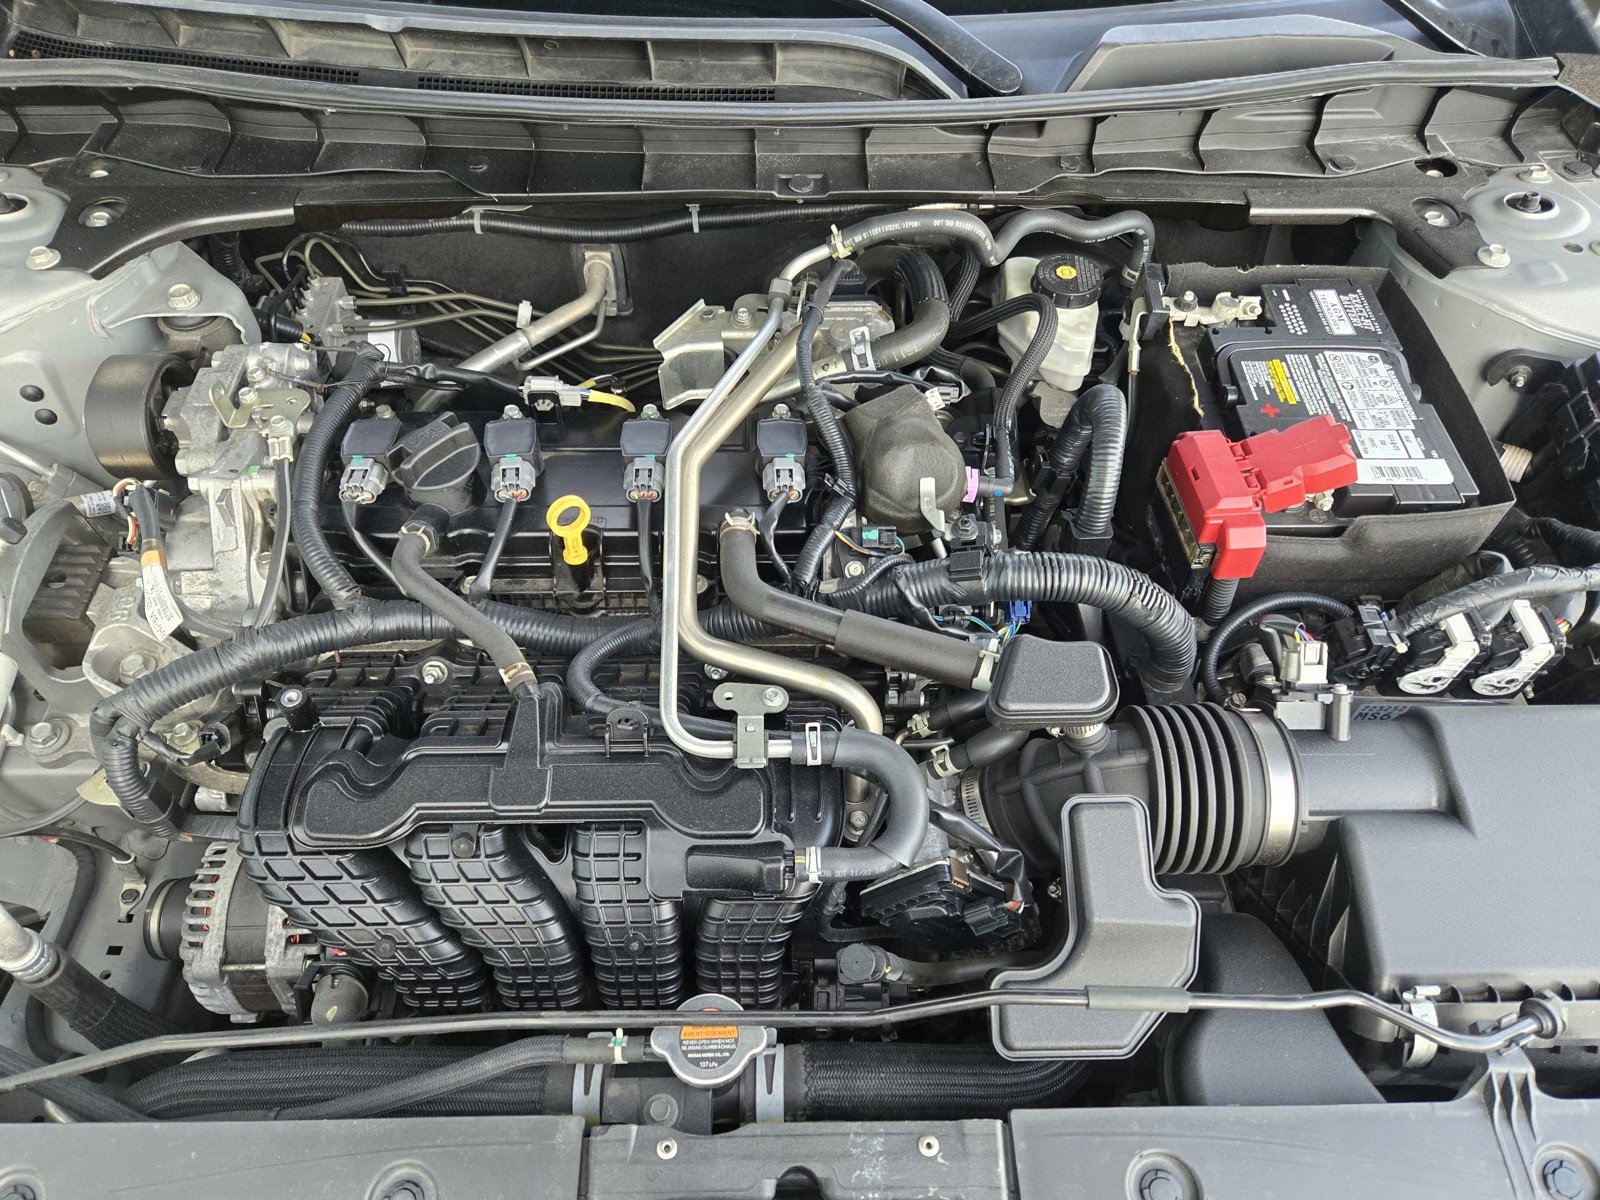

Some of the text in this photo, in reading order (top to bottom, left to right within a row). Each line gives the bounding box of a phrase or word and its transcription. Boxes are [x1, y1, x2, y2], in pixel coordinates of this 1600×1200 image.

[1319, 293, 1341, 331] TECHNOLOGY
[1329, 302, 1346, 324] AGM
[1339, 295, 1364, 328] BATTERY
[1354, 711, 1393, 720] MS6
